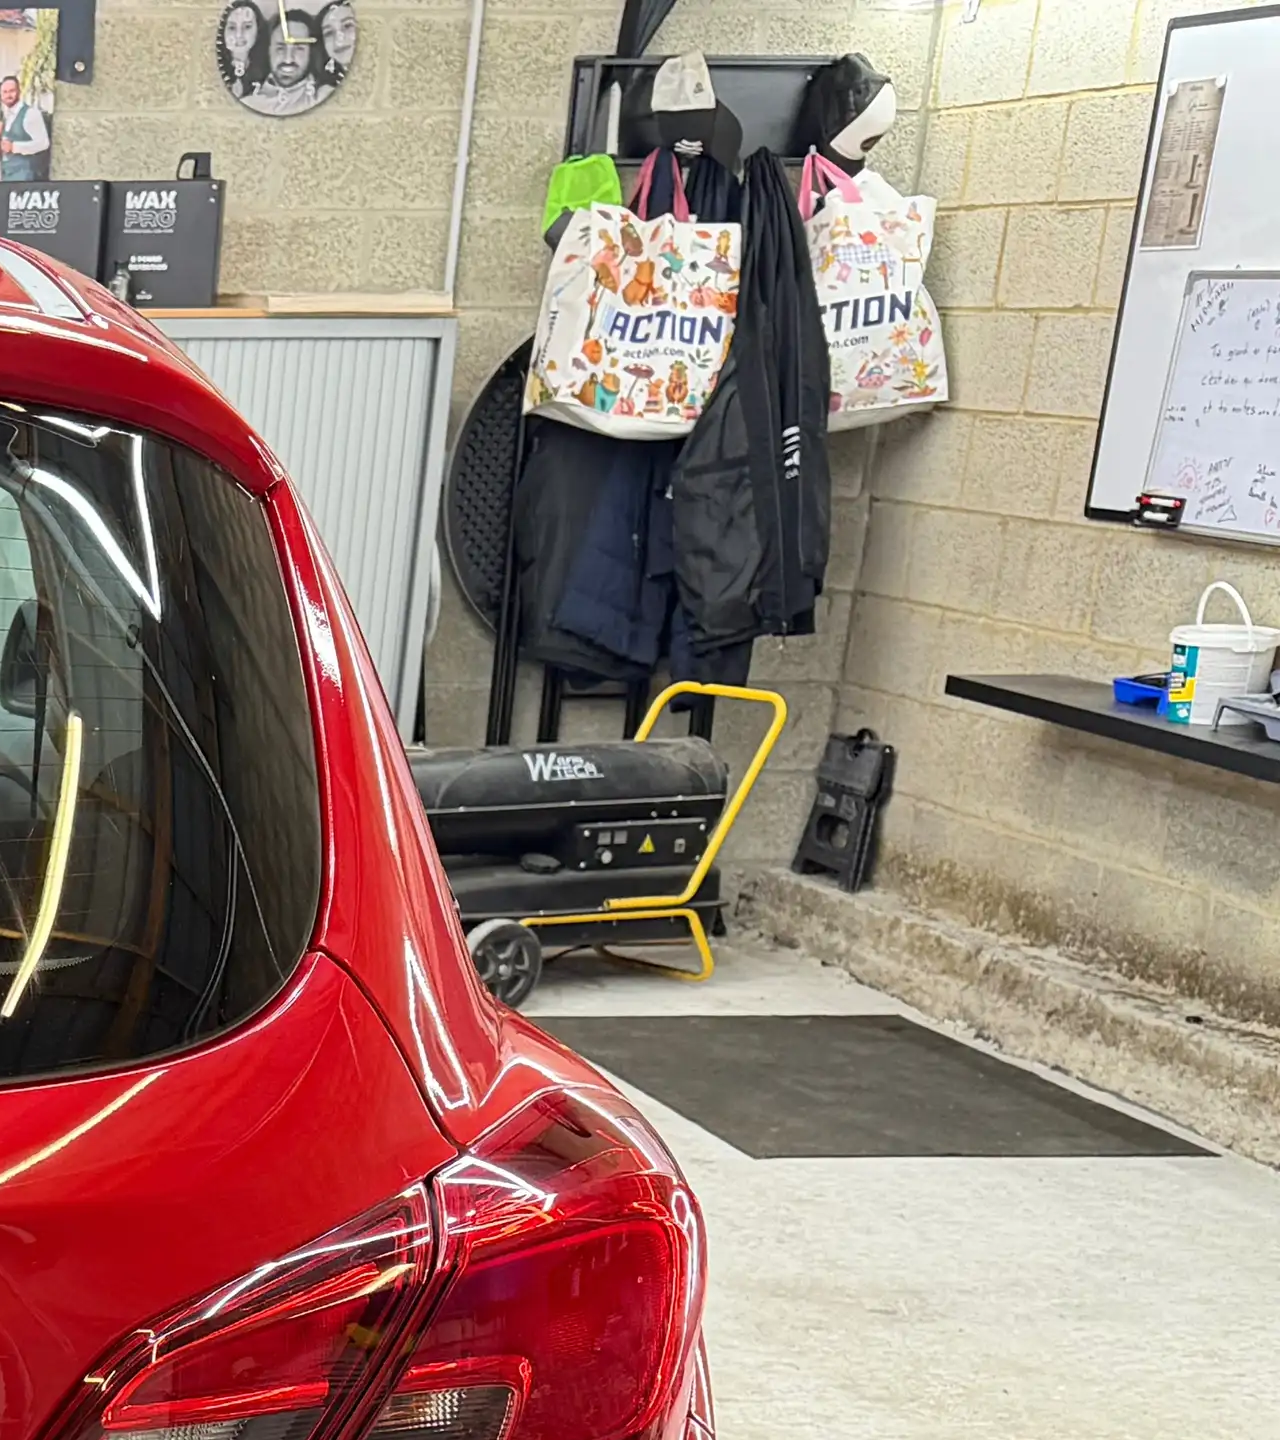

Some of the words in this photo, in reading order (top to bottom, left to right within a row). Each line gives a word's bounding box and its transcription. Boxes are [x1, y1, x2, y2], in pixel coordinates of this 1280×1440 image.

[9, 190, 60, 209] WAX
[124, 189, 177, 209] WAX
[8, 209, 60, 229] PRO
[123, 209, 176, 230] PRO
[609, 311, 724, 345] ACTION
